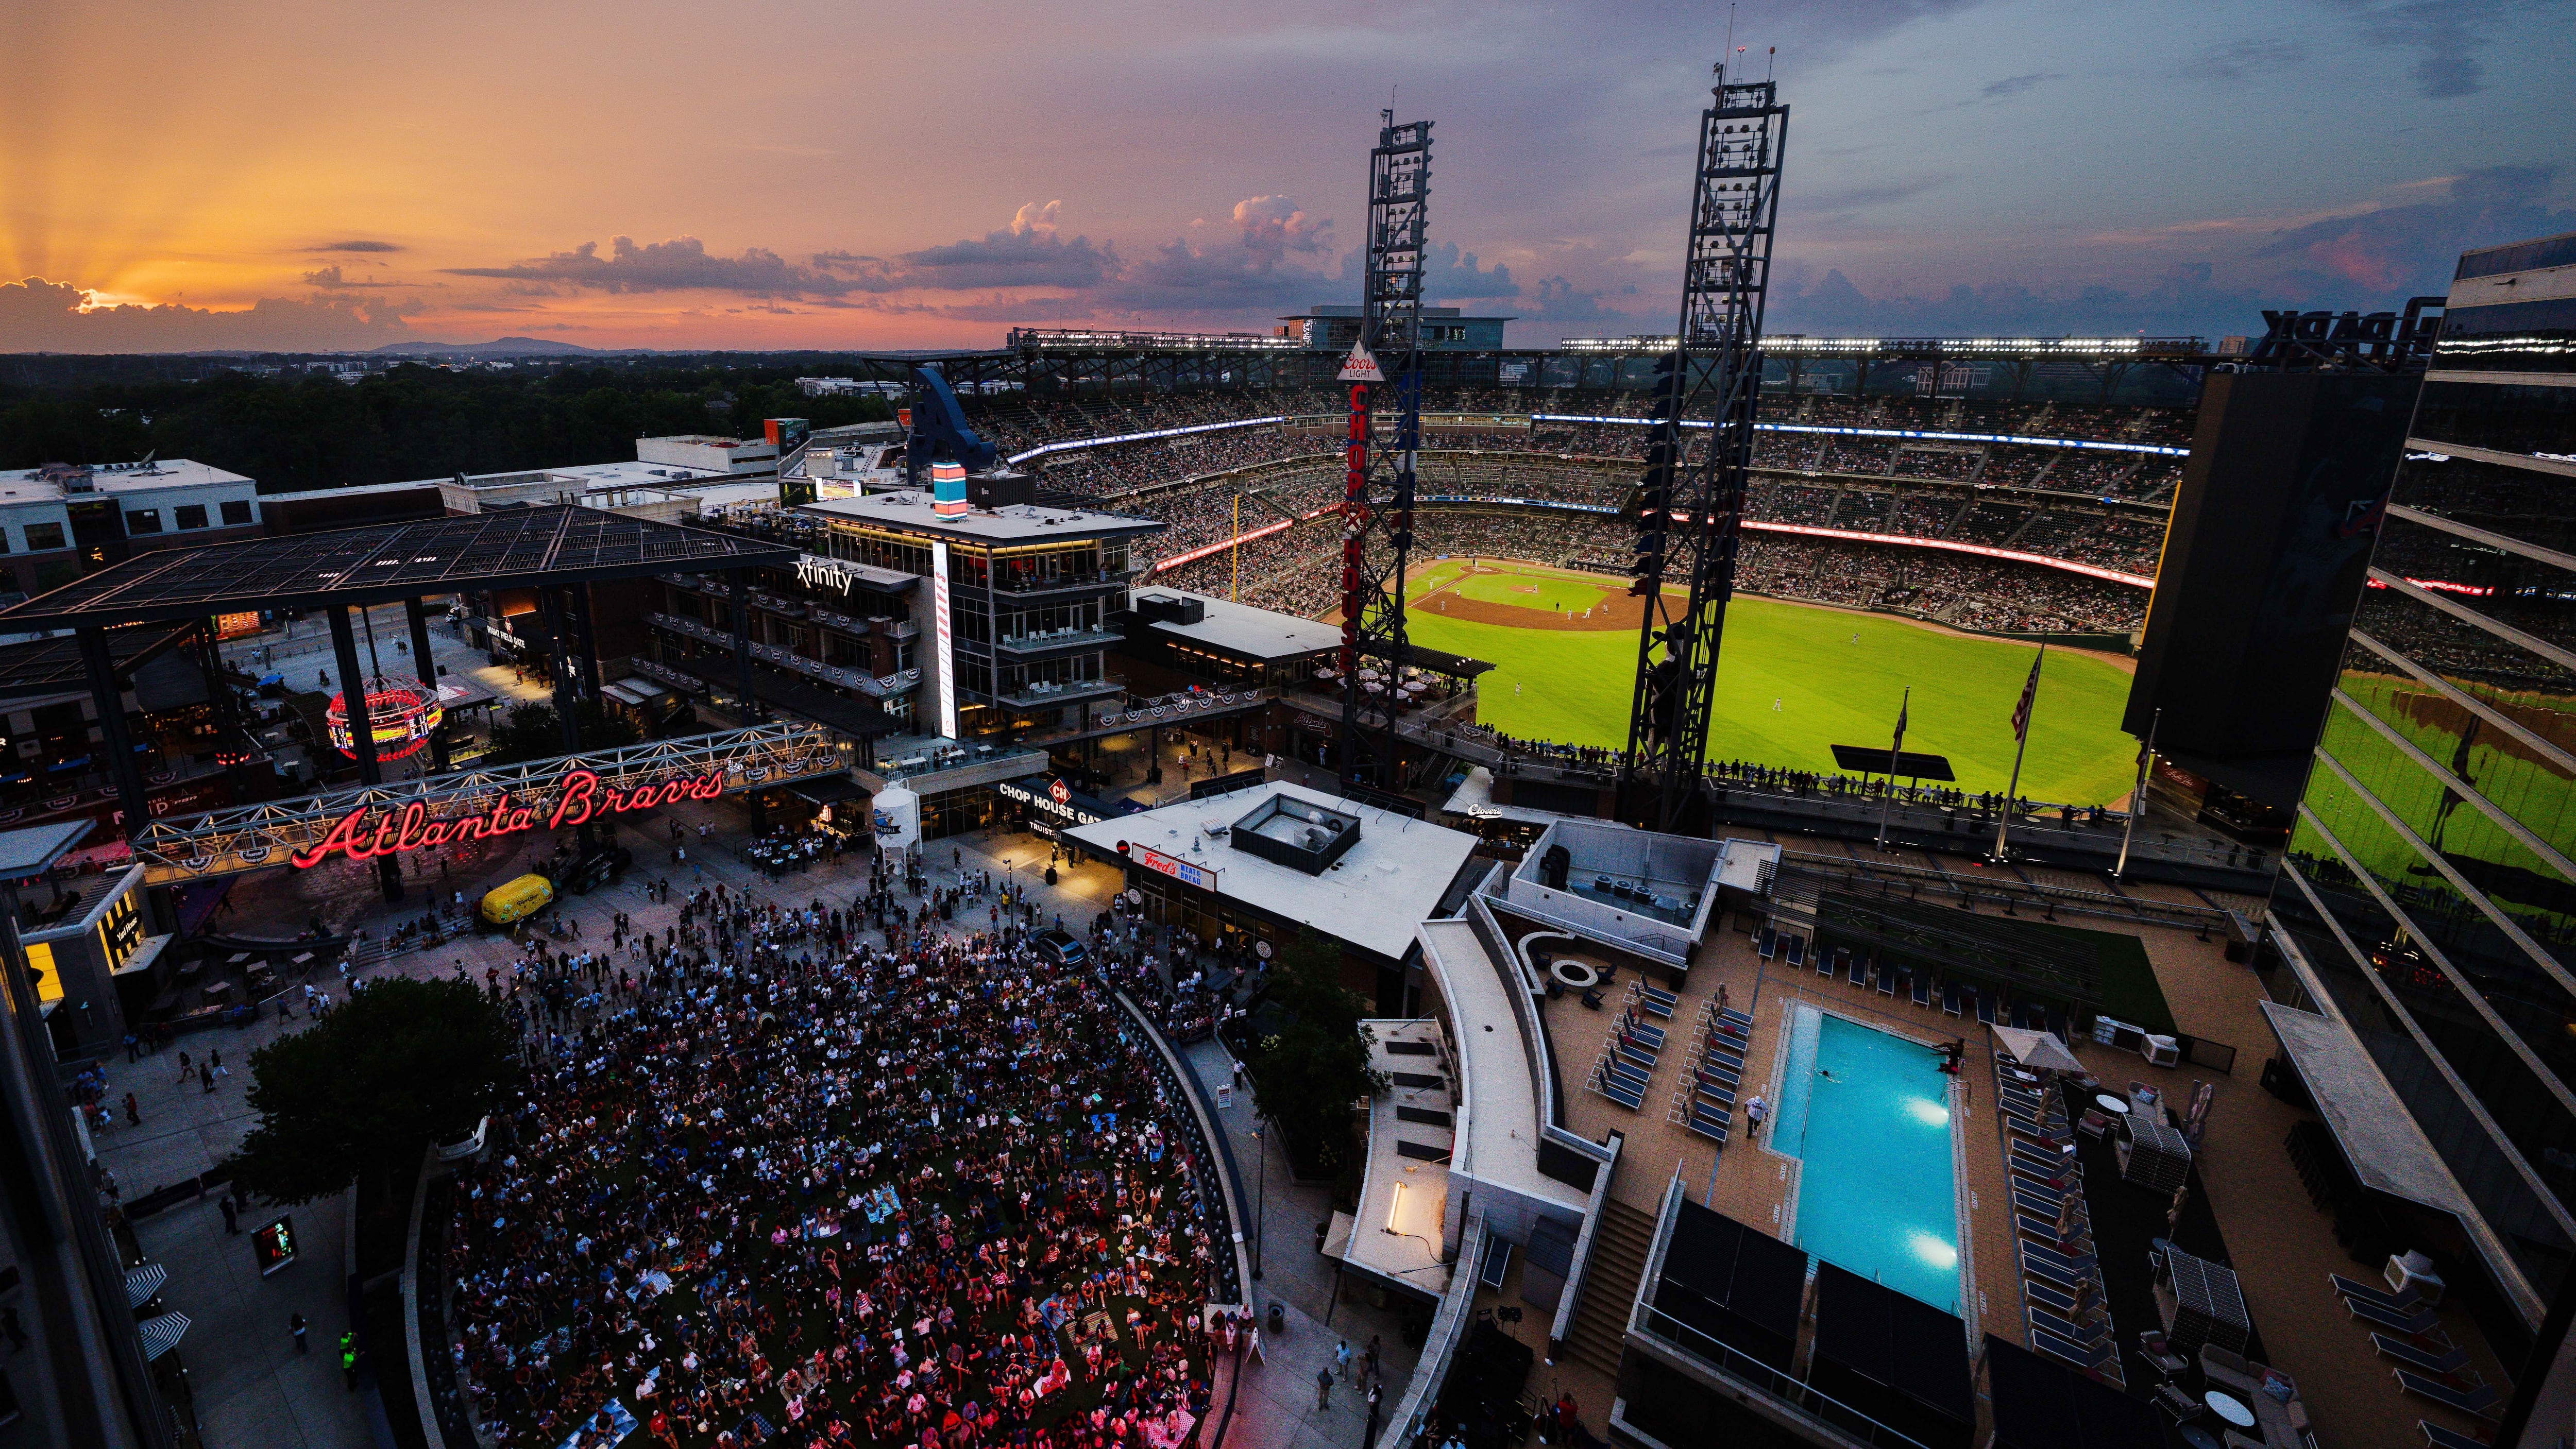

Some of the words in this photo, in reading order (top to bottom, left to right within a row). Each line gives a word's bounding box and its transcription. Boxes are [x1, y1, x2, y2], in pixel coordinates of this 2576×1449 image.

[1344, 353, 1377, 370] Coors
[1349, 370, 1370, 379] LIGHT
[2002, 551, 2041, 561] ROTO-ROOTER
[796, 558, 853, 596] xfinity
[936, 571, 949, 639] BRAVES
[487, 625, 500, 639] RIGHT
[500, 630, 514, 643] FIELD
[513, 637, 526, 649] GATE
[1294, 711, 1329, 730] Atlanta
[1053, 786, 1066, 800] CH
[999, 783, 1031, 803] CHOP
[1034, 795, 1075, 821] HOUSE
[1078, 811, 1104, 825] GAT
[1467, 803, 1502, 816] Closer's
[292, 795, 533, 868] Atlanta
[550, 771, 722, 829] Braves
[1029, 822, 1052, 836] TRUIST
[587, 853, 604, 866] CASAMIGOS
[1144, 853, 1176, 875] Fred's
[1180, 864, 1196, 875] MEAT
[1180, 872, 1201, 886] BREAD
[117, 927, 127, 942] Yard
[125, 917, 138, 933] House
